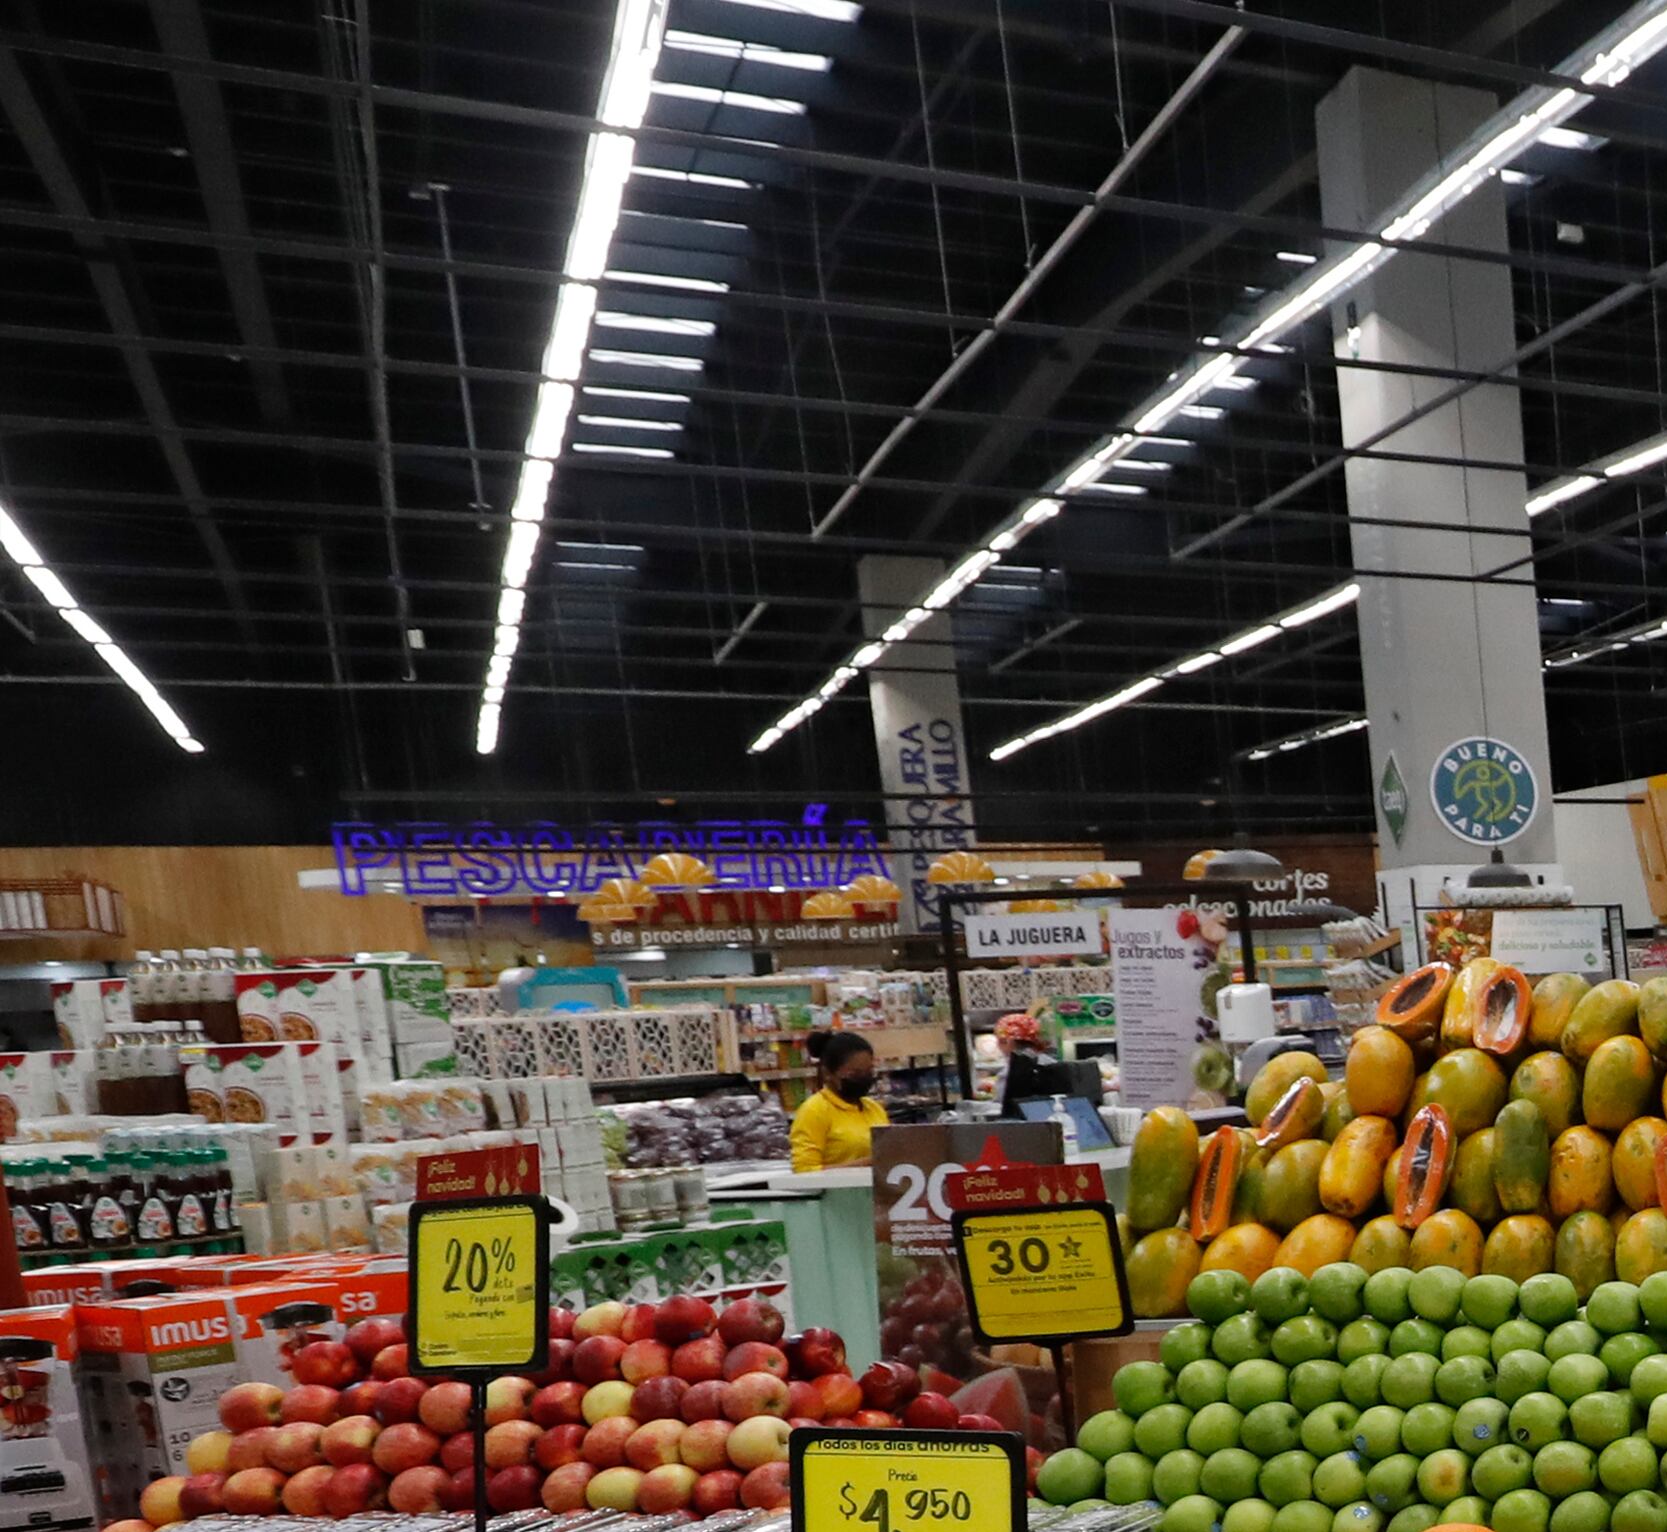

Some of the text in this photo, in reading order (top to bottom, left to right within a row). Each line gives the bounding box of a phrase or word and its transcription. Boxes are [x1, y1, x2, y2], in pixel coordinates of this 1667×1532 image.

[1443, 743, 1523, 775] BUENO
[1443, 803, 1531, 840] PARA TI
[332, 802, 892, 896] PESCADERÍA
[611, 926, 635, 946] de
[641, 923, 753, 948] procedencia
[758, 929, 770, 948] y
[774, 923, 842, 942] calidad
[979, 925, 1087, 947] LA JUGUERA
[1110, 928, 1154, 946] Jugos
[1117, 943, 1187, 961] extractos
[427, 1160, 457, 1179] ¡Feliz
[427, 1175, 476, 1194] navidad!
[963, 1175, 998, 1190] ¡Feliz
[965, 1186, 1025, 1203] navidad!
[443, 1236, 515, 1294] 20%
[987, 1237, 1050, 1275] 30
[169, 1431, 191, 1444] 10
[817, 1439, 858, 1451] Todos
[860, 1439, 881, 1451] los
[883, 1440, 914, 1452] días
[173, 1447, 183, 1462] 6
[888, 1468, 918, 1482] Precio
